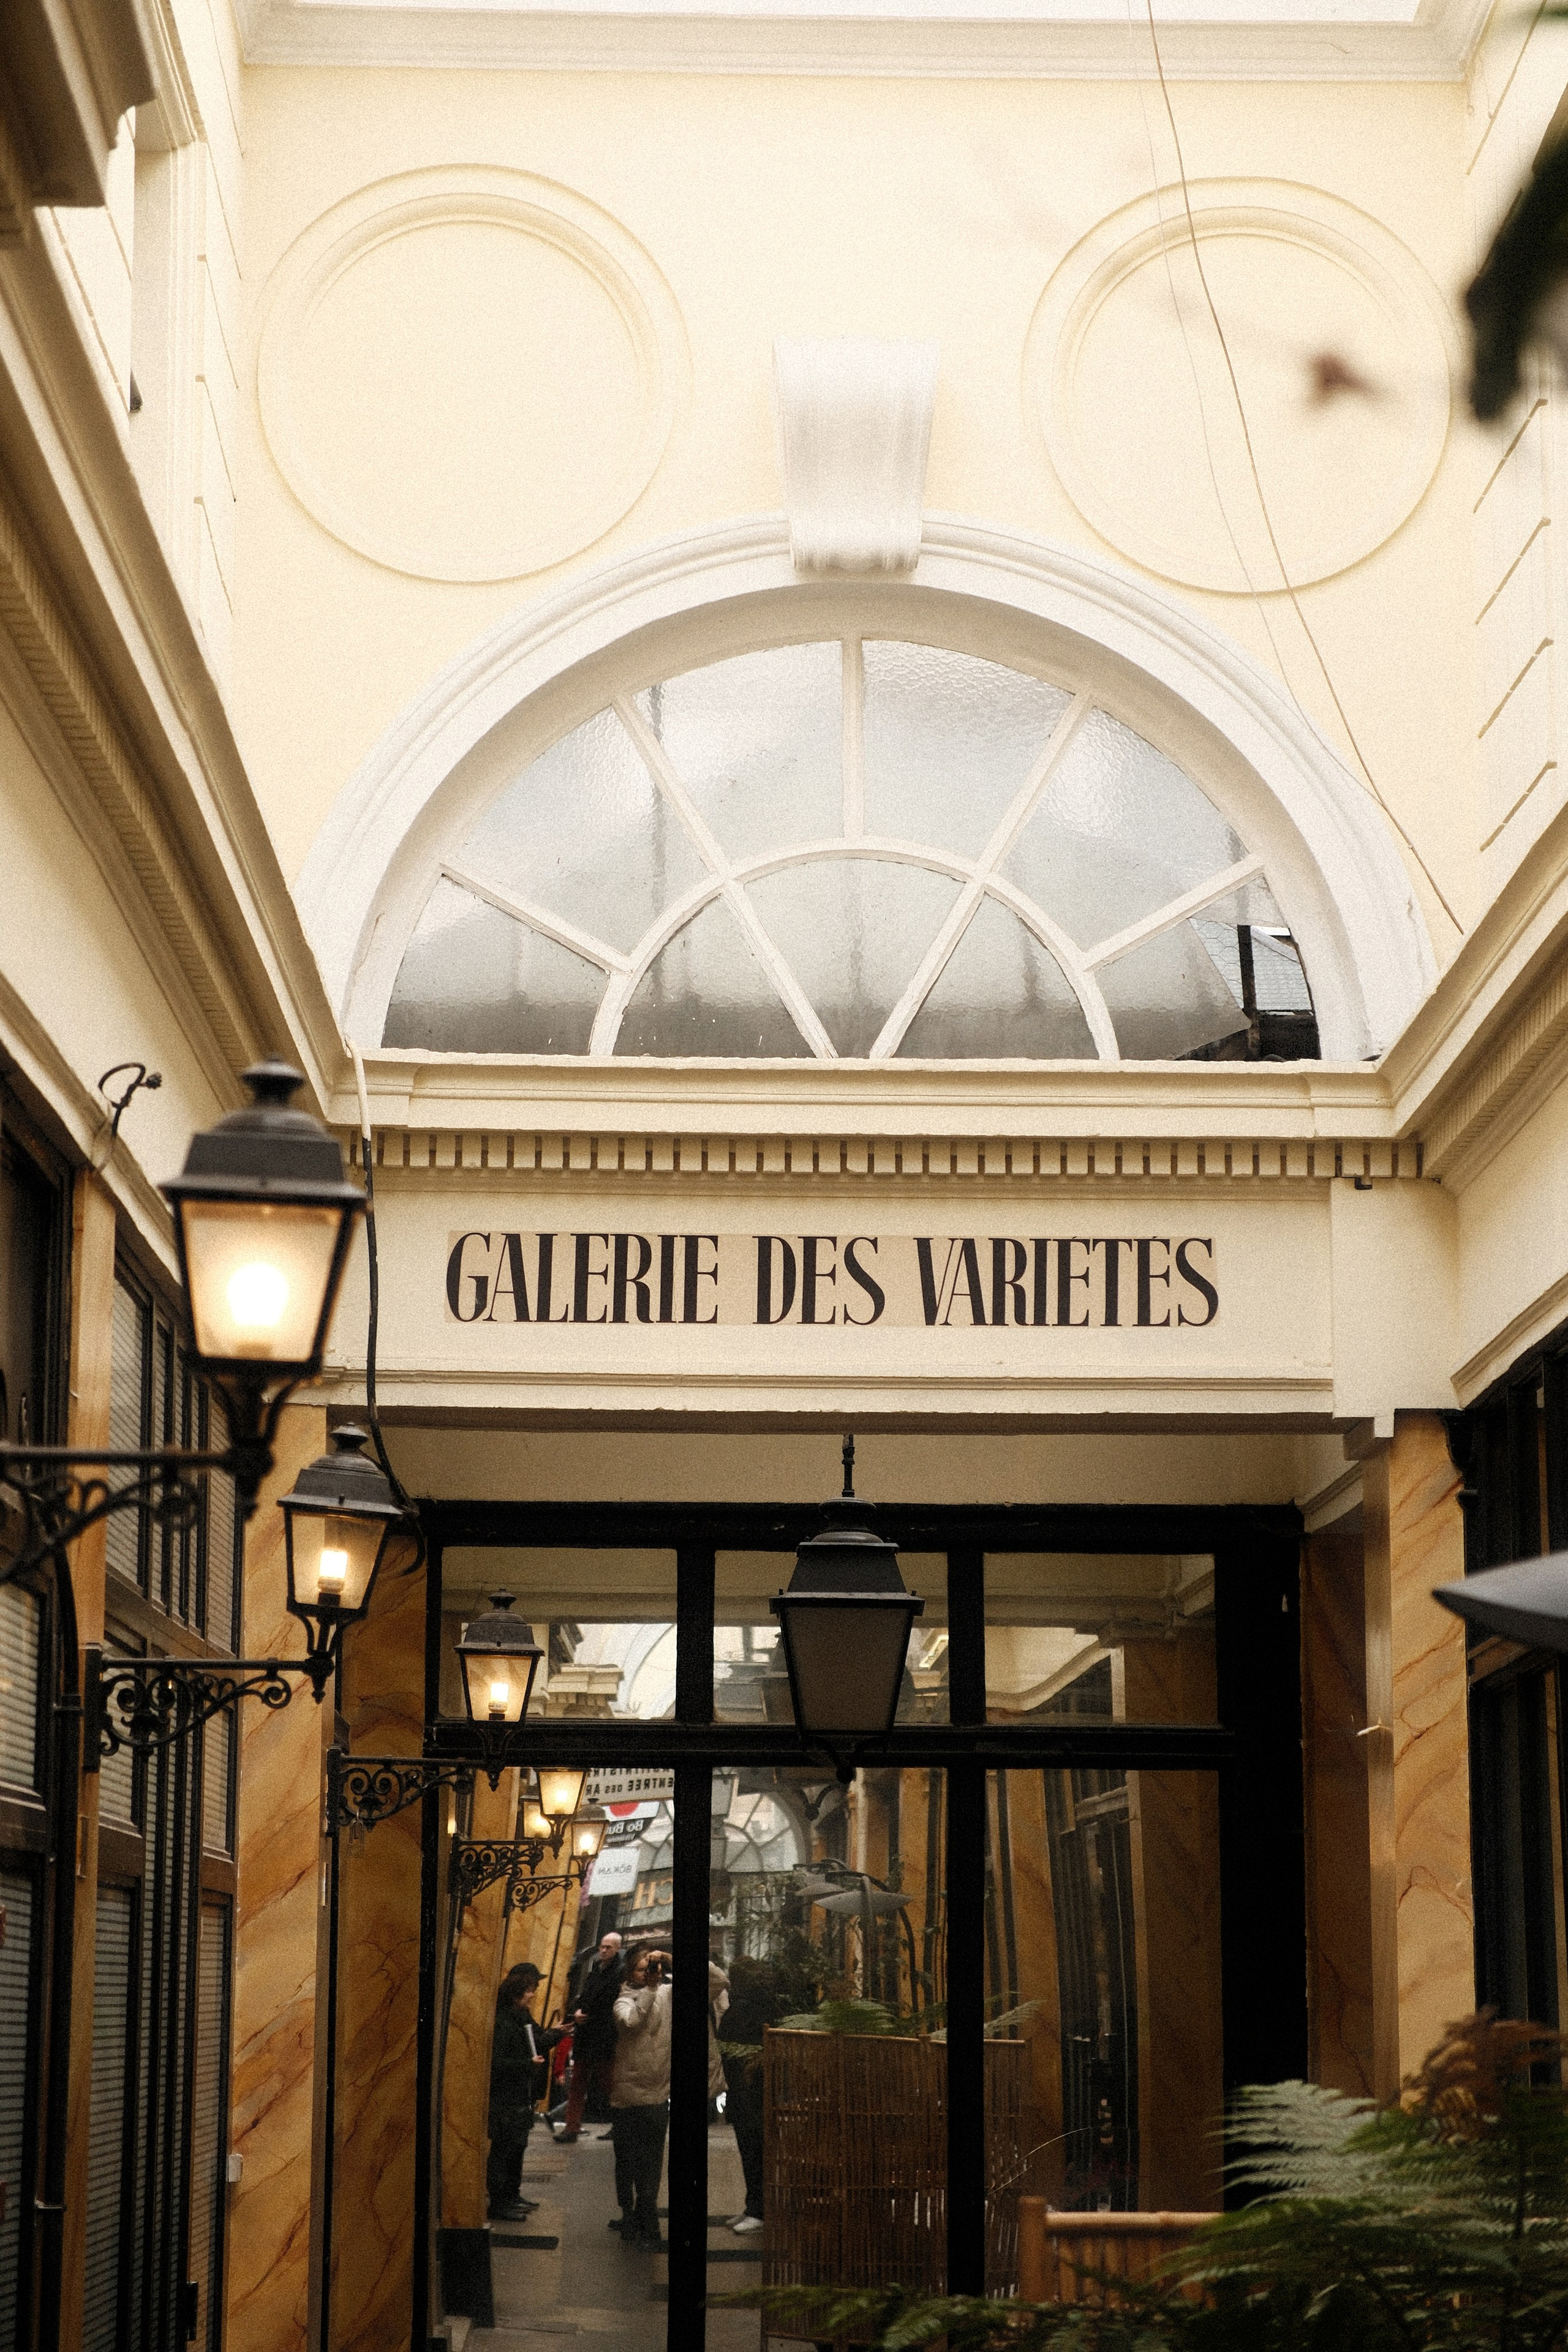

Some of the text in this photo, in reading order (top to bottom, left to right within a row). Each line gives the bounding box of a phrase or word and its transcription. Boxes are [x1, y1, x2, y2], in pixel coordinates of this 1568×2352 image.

[445, 1232, 1219, 1327] GALERIE DES VARIÉTÉS
